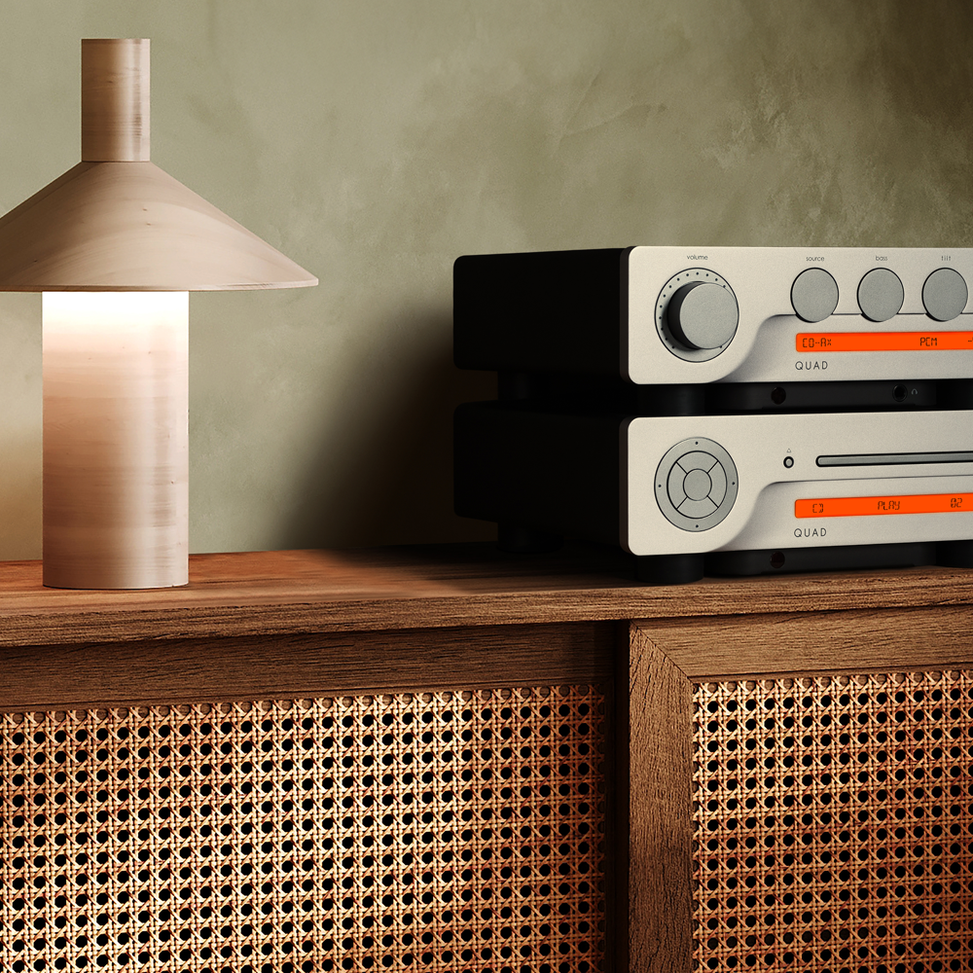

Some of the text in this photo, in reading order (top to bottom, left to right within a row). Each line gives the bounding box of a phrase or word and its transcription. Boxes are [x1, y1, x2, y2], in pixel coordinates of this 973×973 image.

[686, 253, 709, 261] volume
[919, 336, 938, 347] PCM
[795, 360, 828, 371] QUAD
[877, 500, 901, 511] PLAY
[793, 527, 827, 538] QUAD
